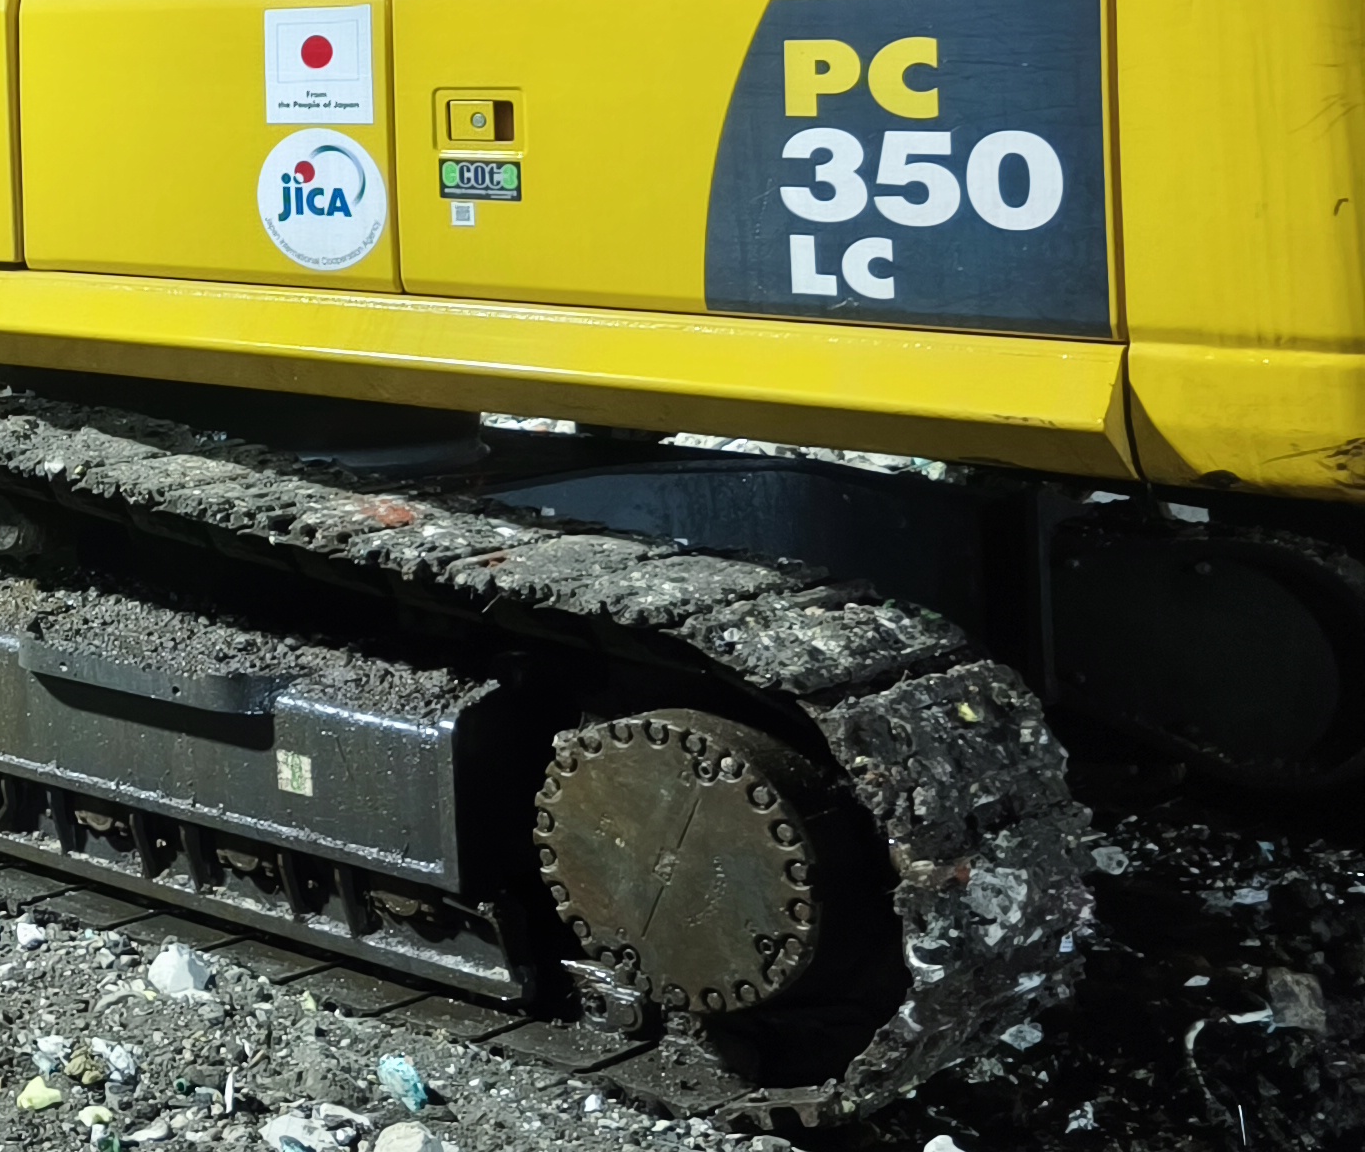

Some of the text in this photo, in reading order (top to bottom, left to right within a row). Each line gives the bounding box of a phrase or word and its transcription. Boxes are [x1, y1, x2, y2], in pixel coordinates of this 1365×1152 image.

[278, 100, 360, 109] the People of Japan
[306, 90, 327, 98] From
[784, 36, 939, 119] PC
[780, 127, 1064, 231] 350
[264, 217, 382, 265] Japan International Cooperation Agency
[789, 234, 895, 299] LC
